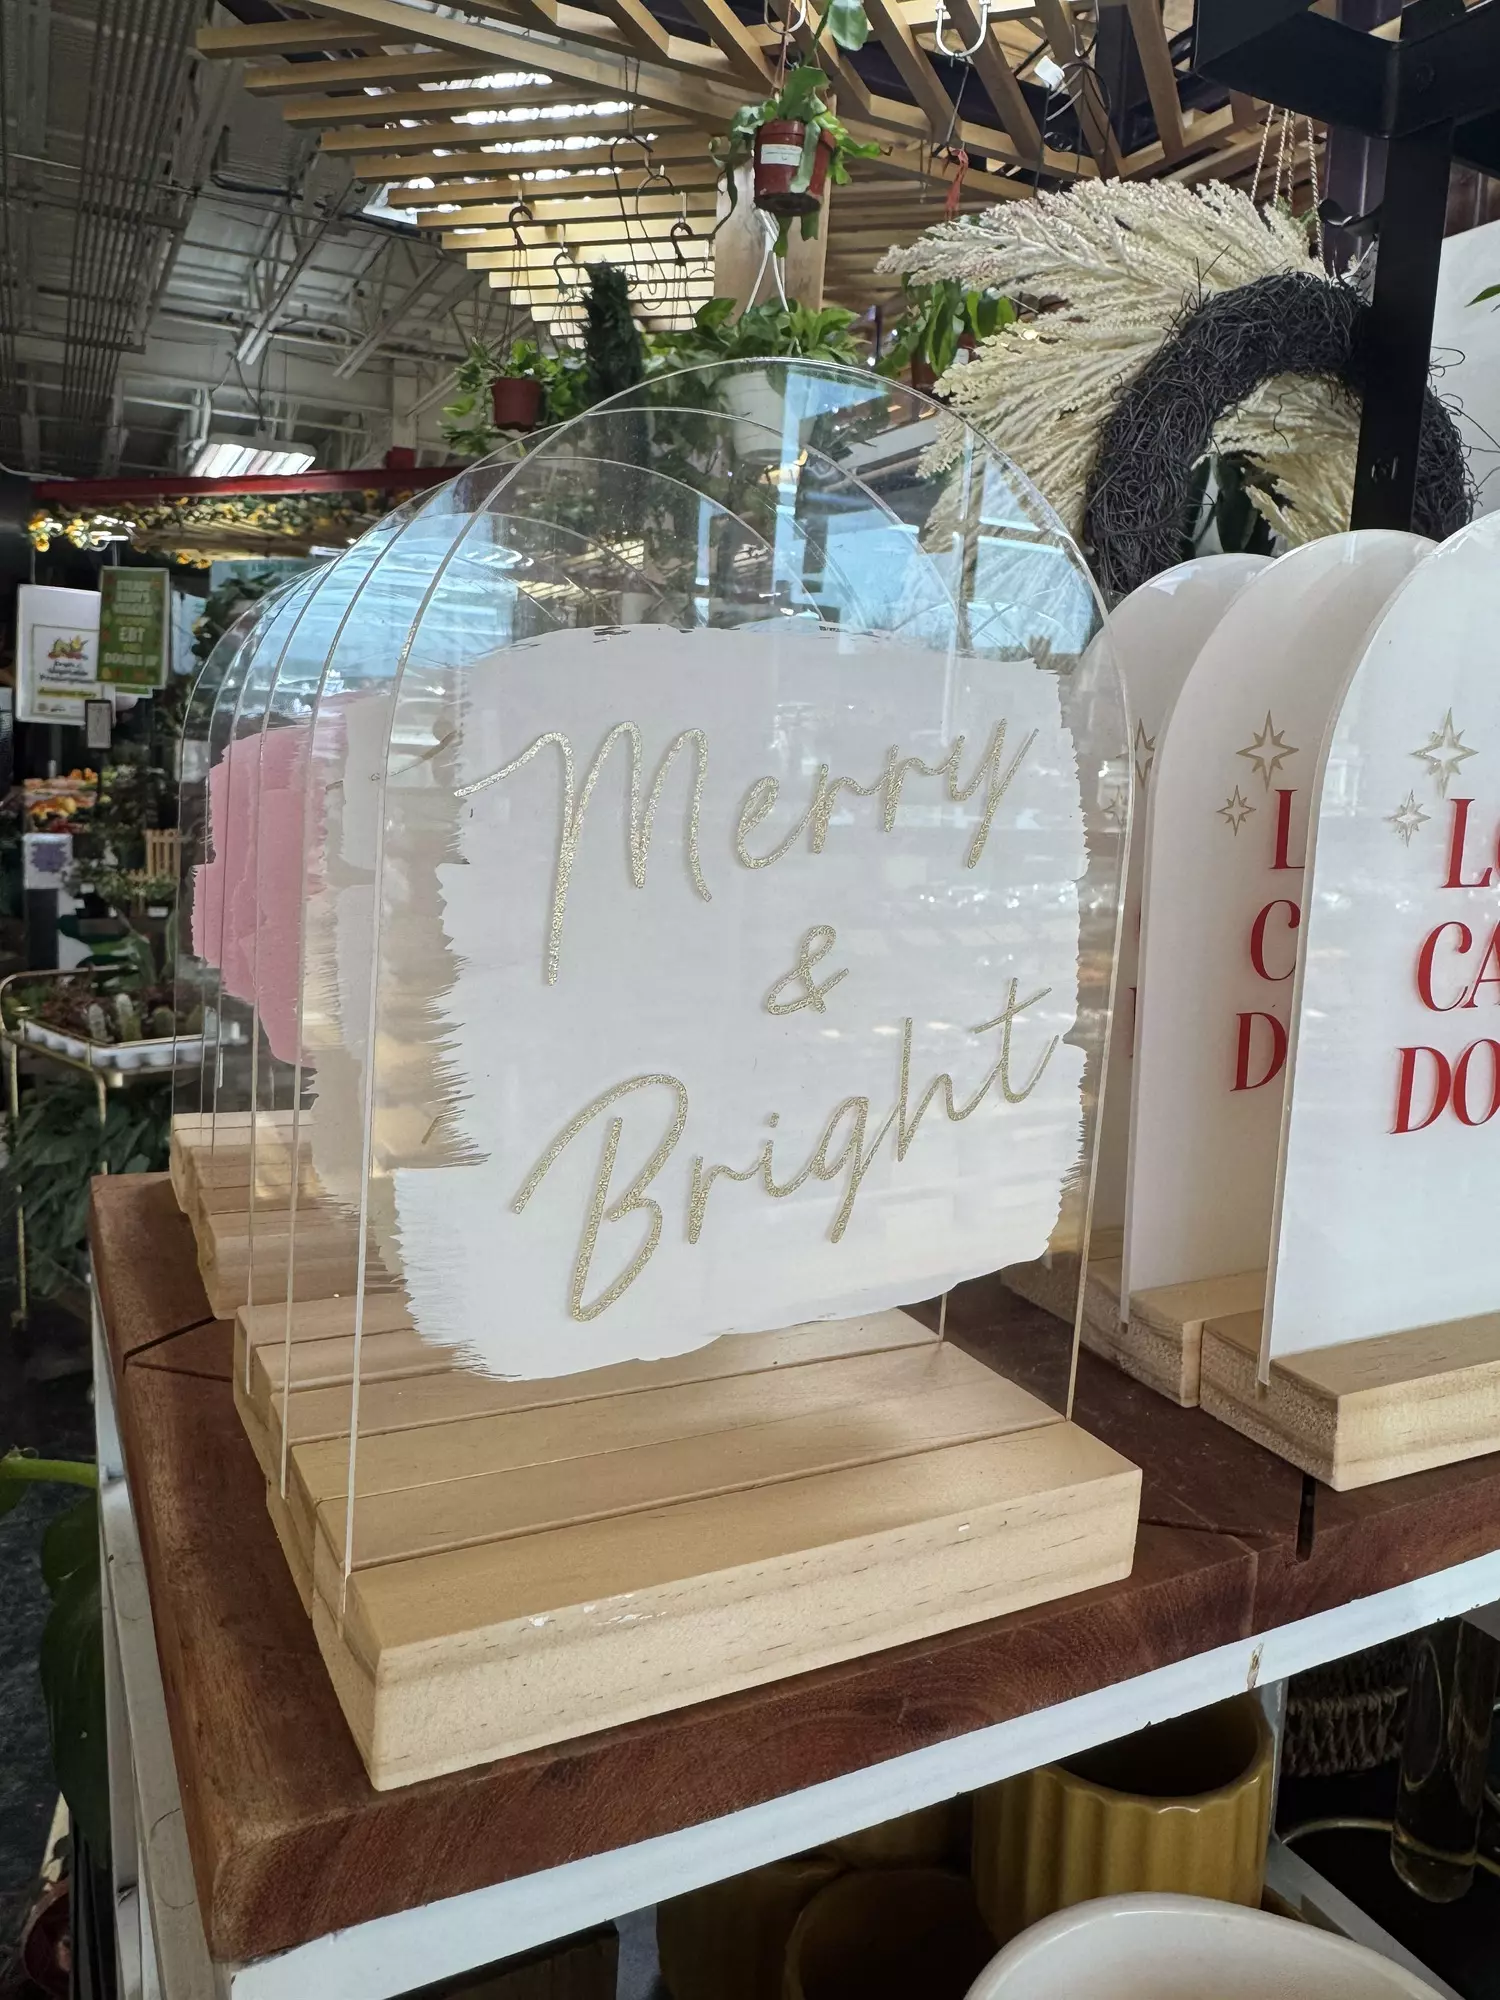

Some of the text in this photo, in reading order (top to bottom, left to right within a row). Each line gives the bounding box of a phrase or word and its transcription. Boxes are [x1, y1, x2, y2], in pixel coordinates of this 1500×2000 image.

[453, 718, 1041, 986] Merry
[1438, 796, 1500, 890] L
[766, 924, 850, 1016] &
[511, 976, 1060, 1323] Bright
